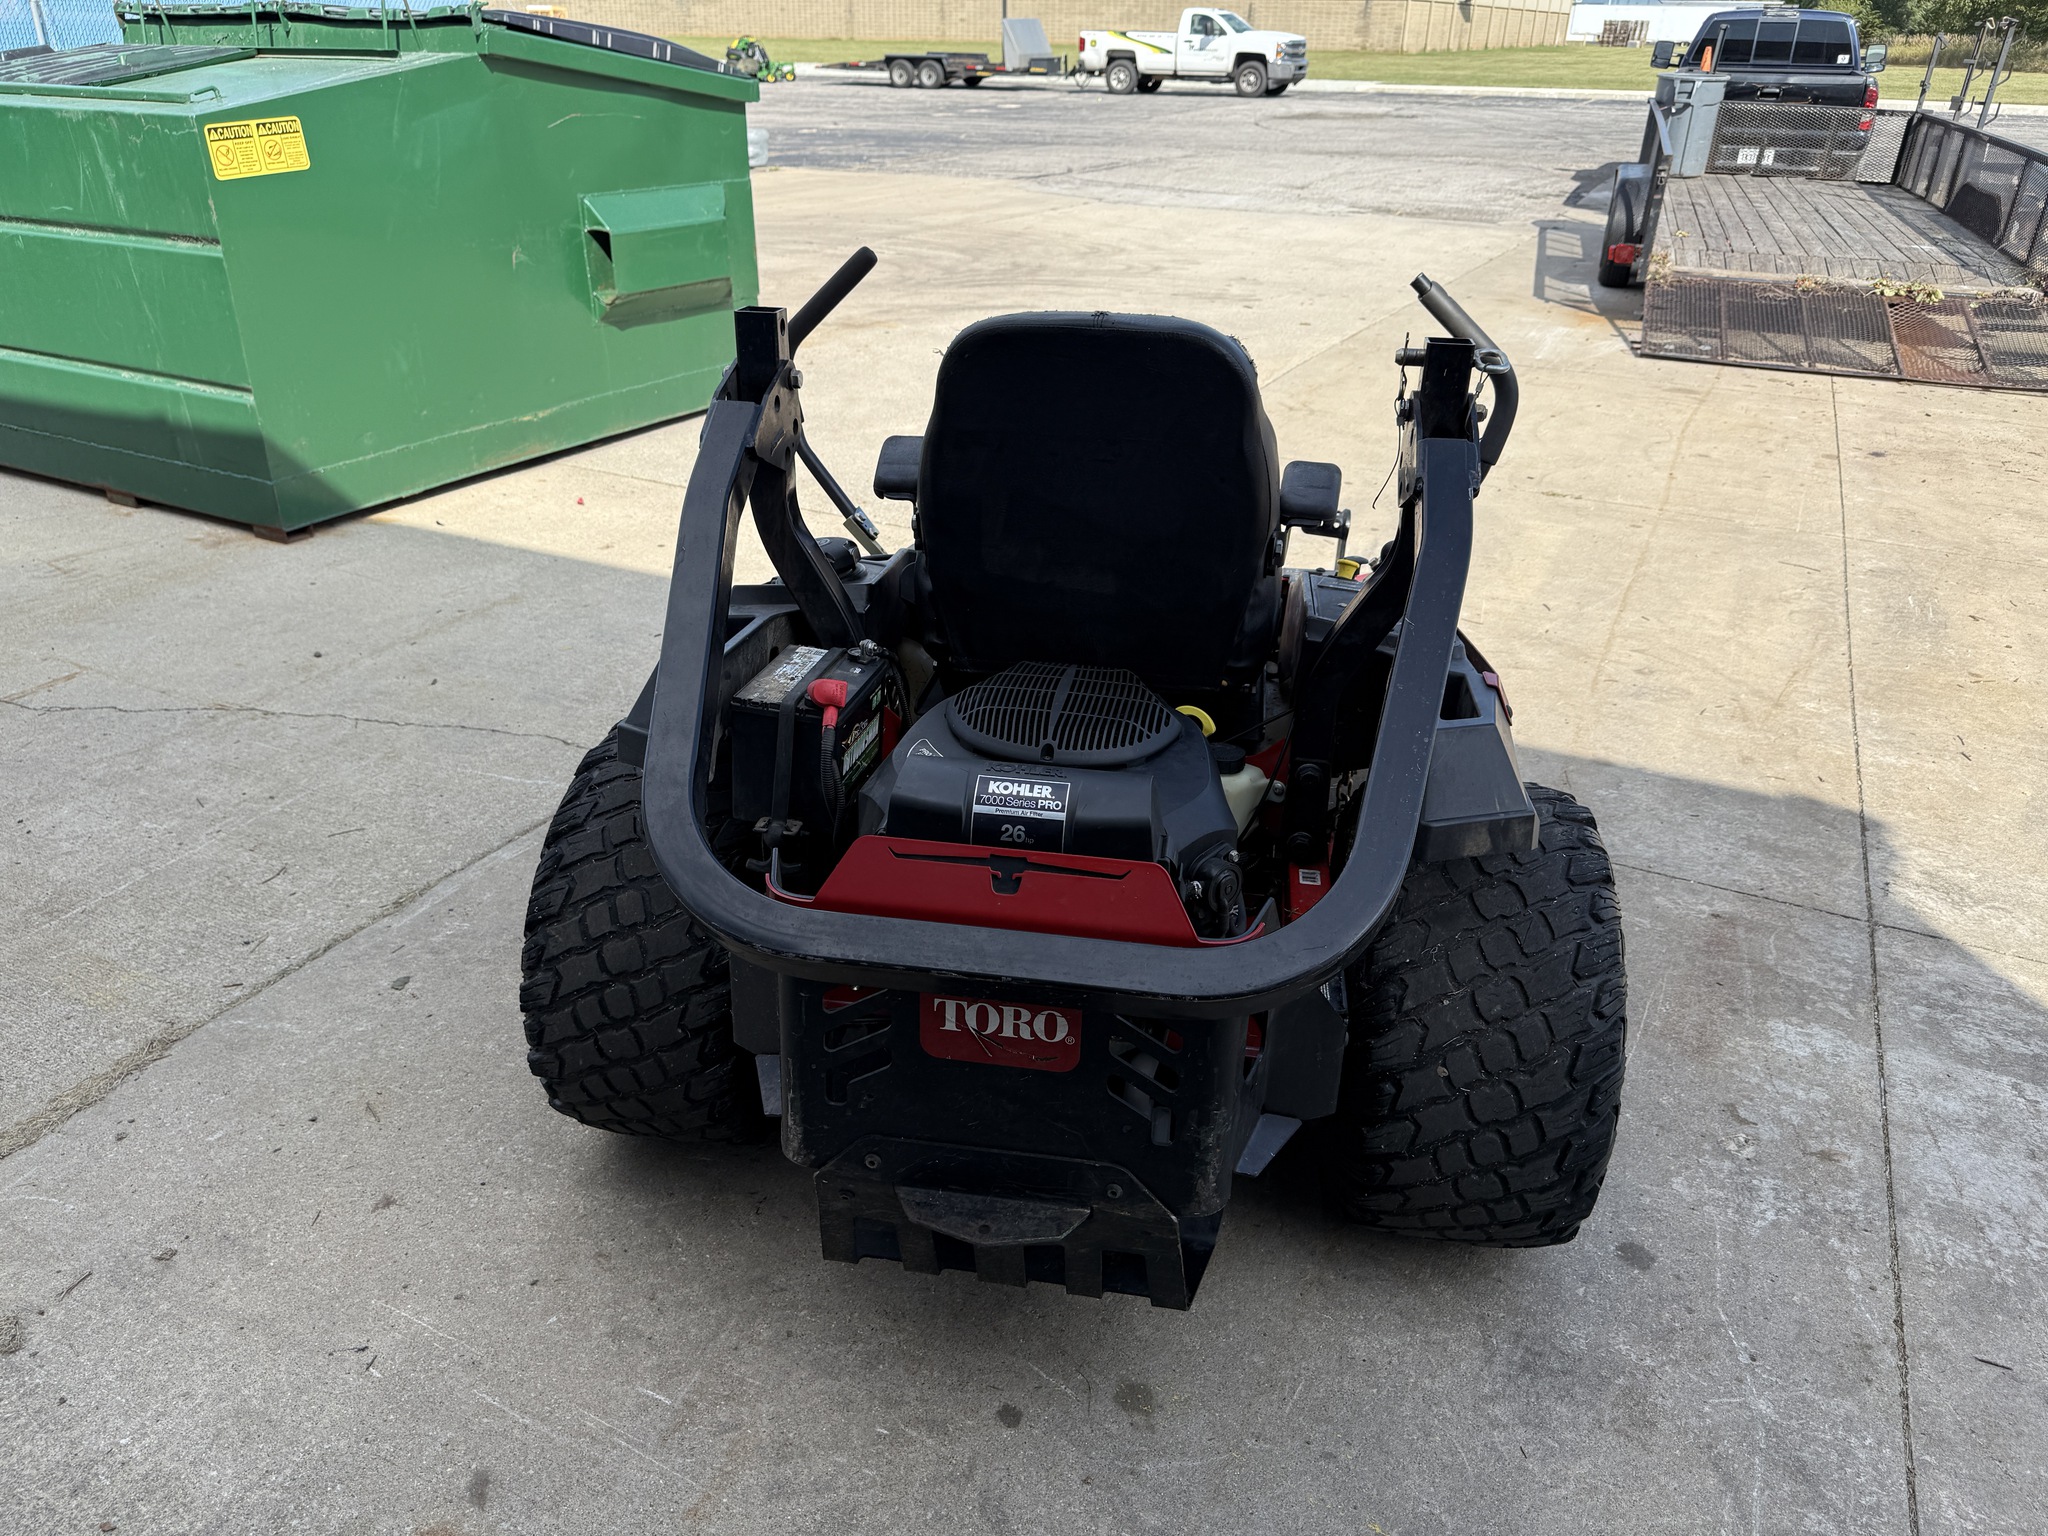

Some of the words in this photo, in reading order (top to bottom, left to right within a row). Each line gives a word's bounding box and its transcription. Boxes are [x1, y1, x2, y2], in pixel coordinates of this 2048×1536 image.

[217, 125, 253, 140] CAUTION
[266, 120, 300, 135] CAUTION
[980, 794, 1005, 805] 7000
[1005, 796, 1036, 808] Series
[1038, 799, 1062, 811] PRO
[995, 807, 1020, 816] Premium
[933, 997, 1070, 1043] TORO
